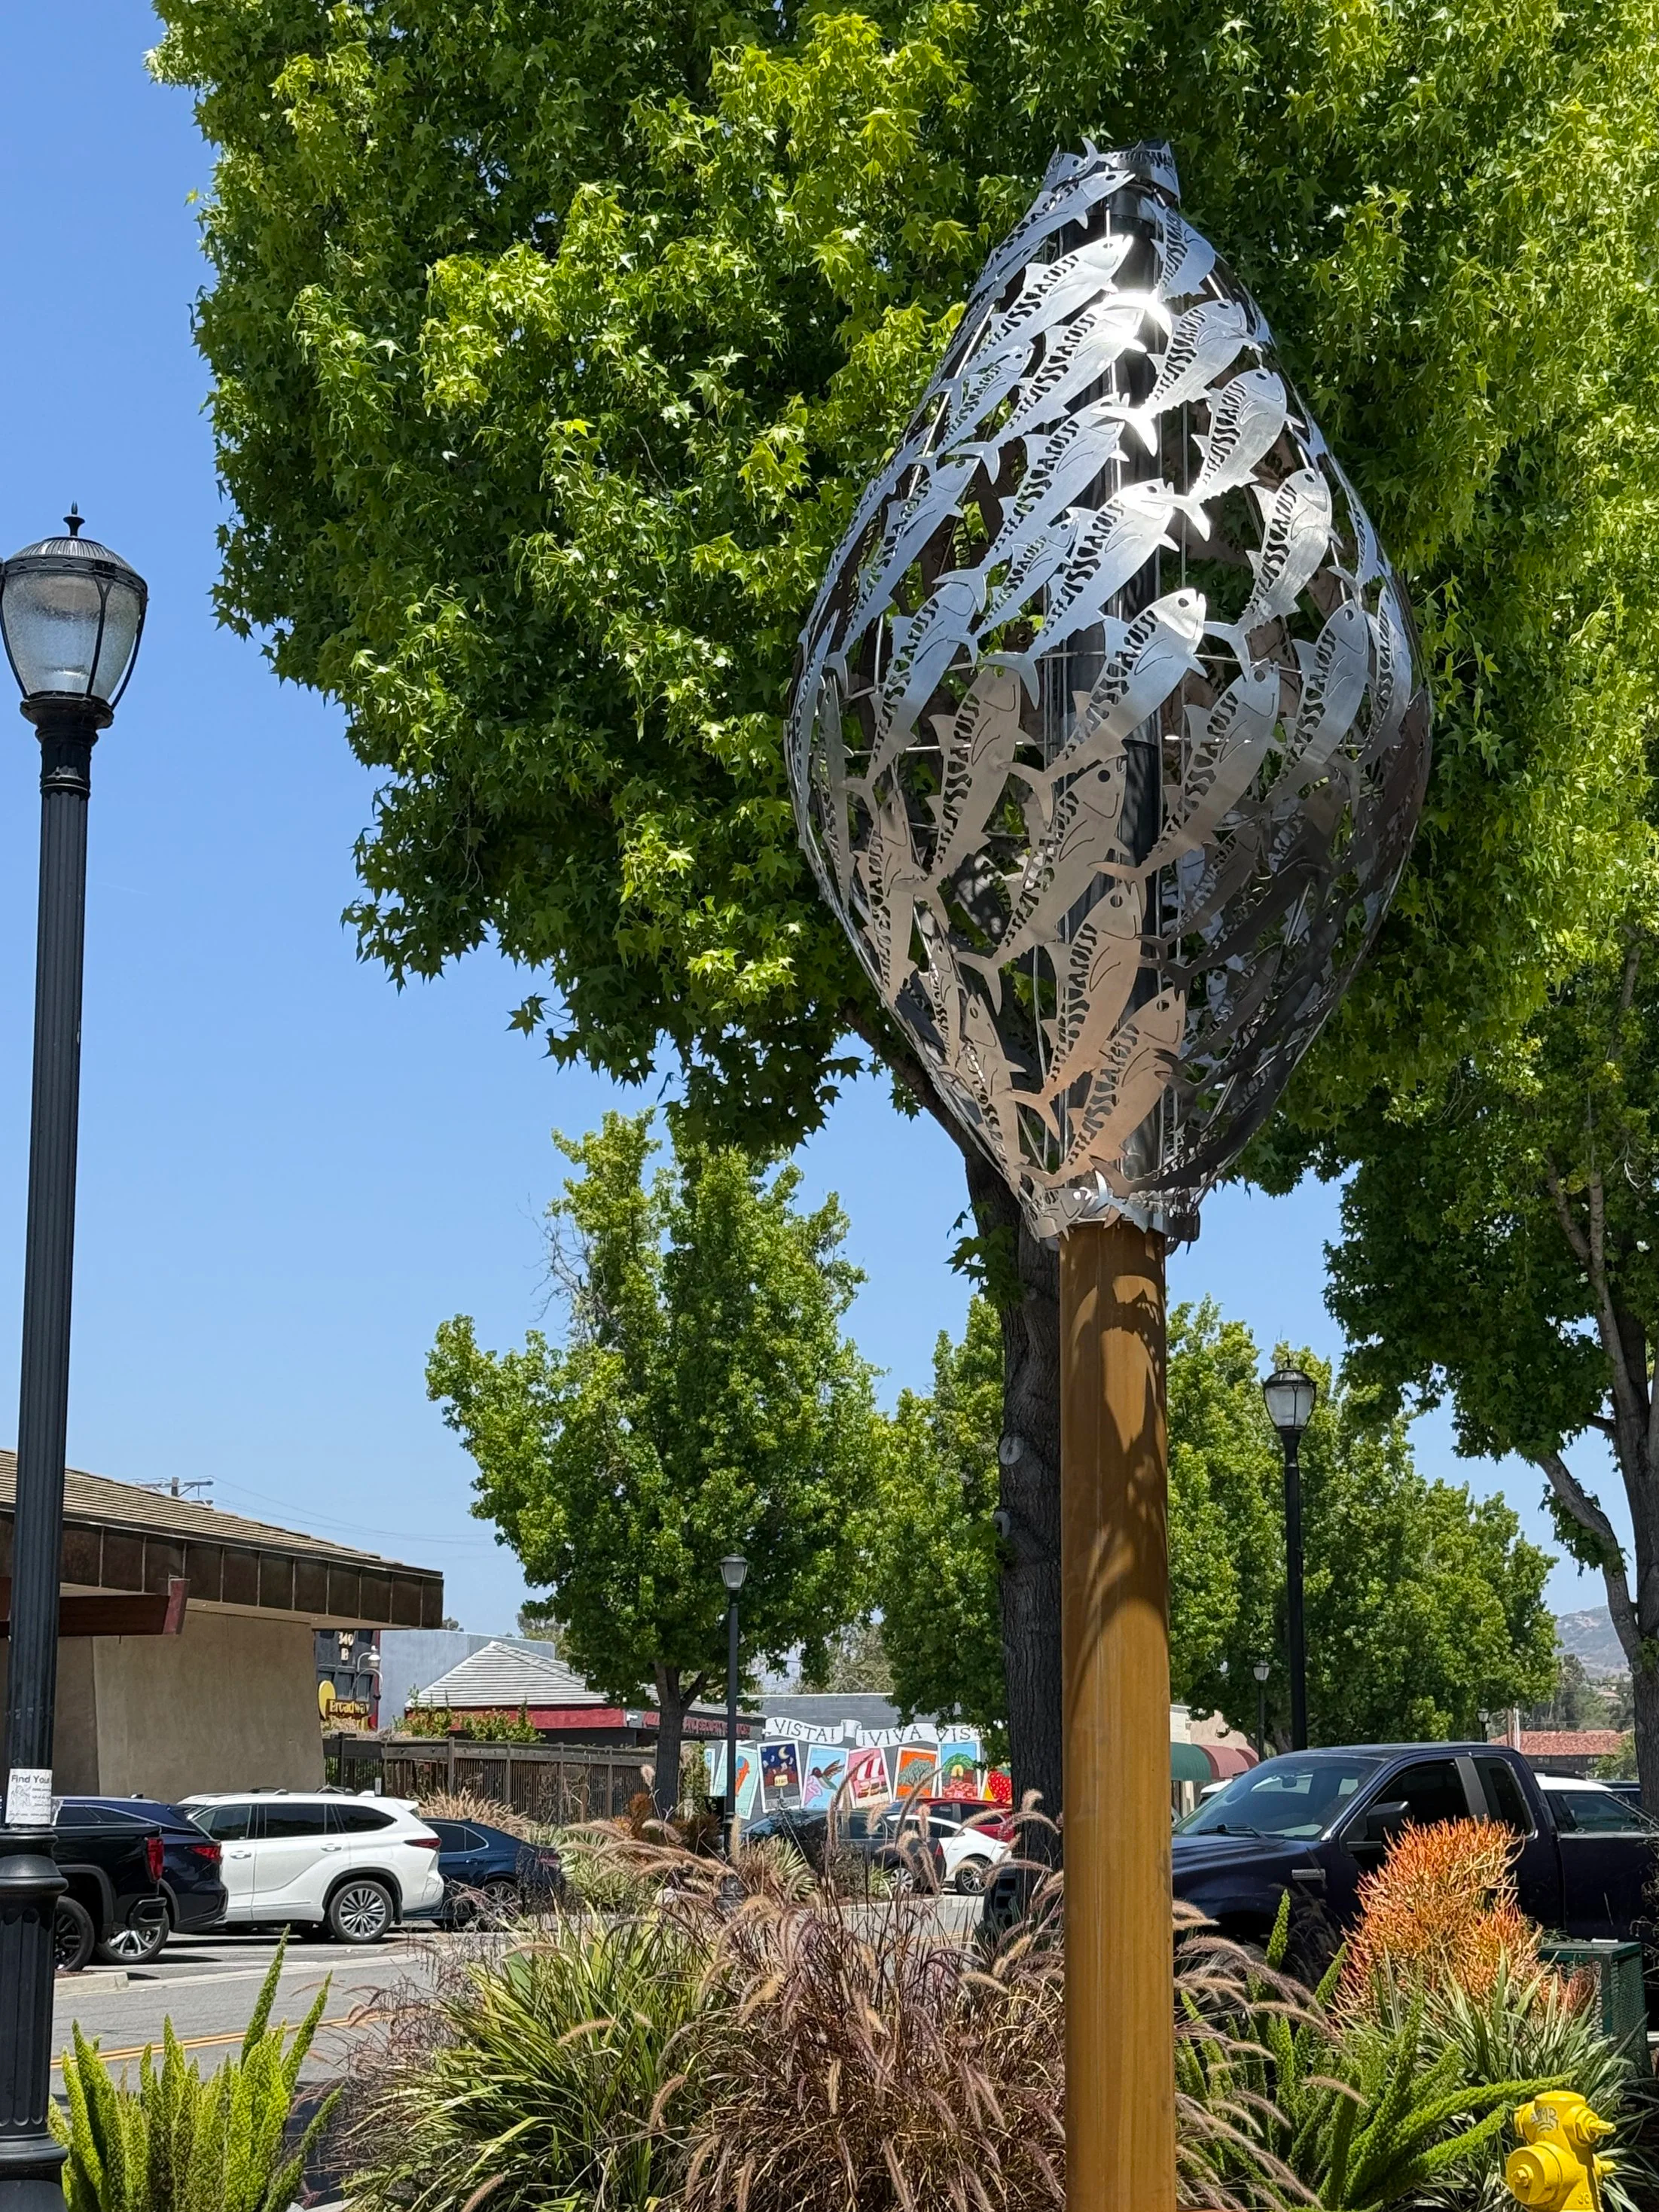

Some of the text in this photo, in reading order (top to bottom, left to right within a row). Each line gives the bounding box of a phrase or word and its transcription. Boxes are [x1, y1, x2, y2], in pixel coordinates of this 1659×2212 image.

[340, 1647, 349, 1661] B
[329, 1700, 370, 1714] Broadway
[773, 1719, 834, 1742] VISTA!
[935, 1727, 974, 1743] VIS
[11, 1775, 31, 1784] Find
